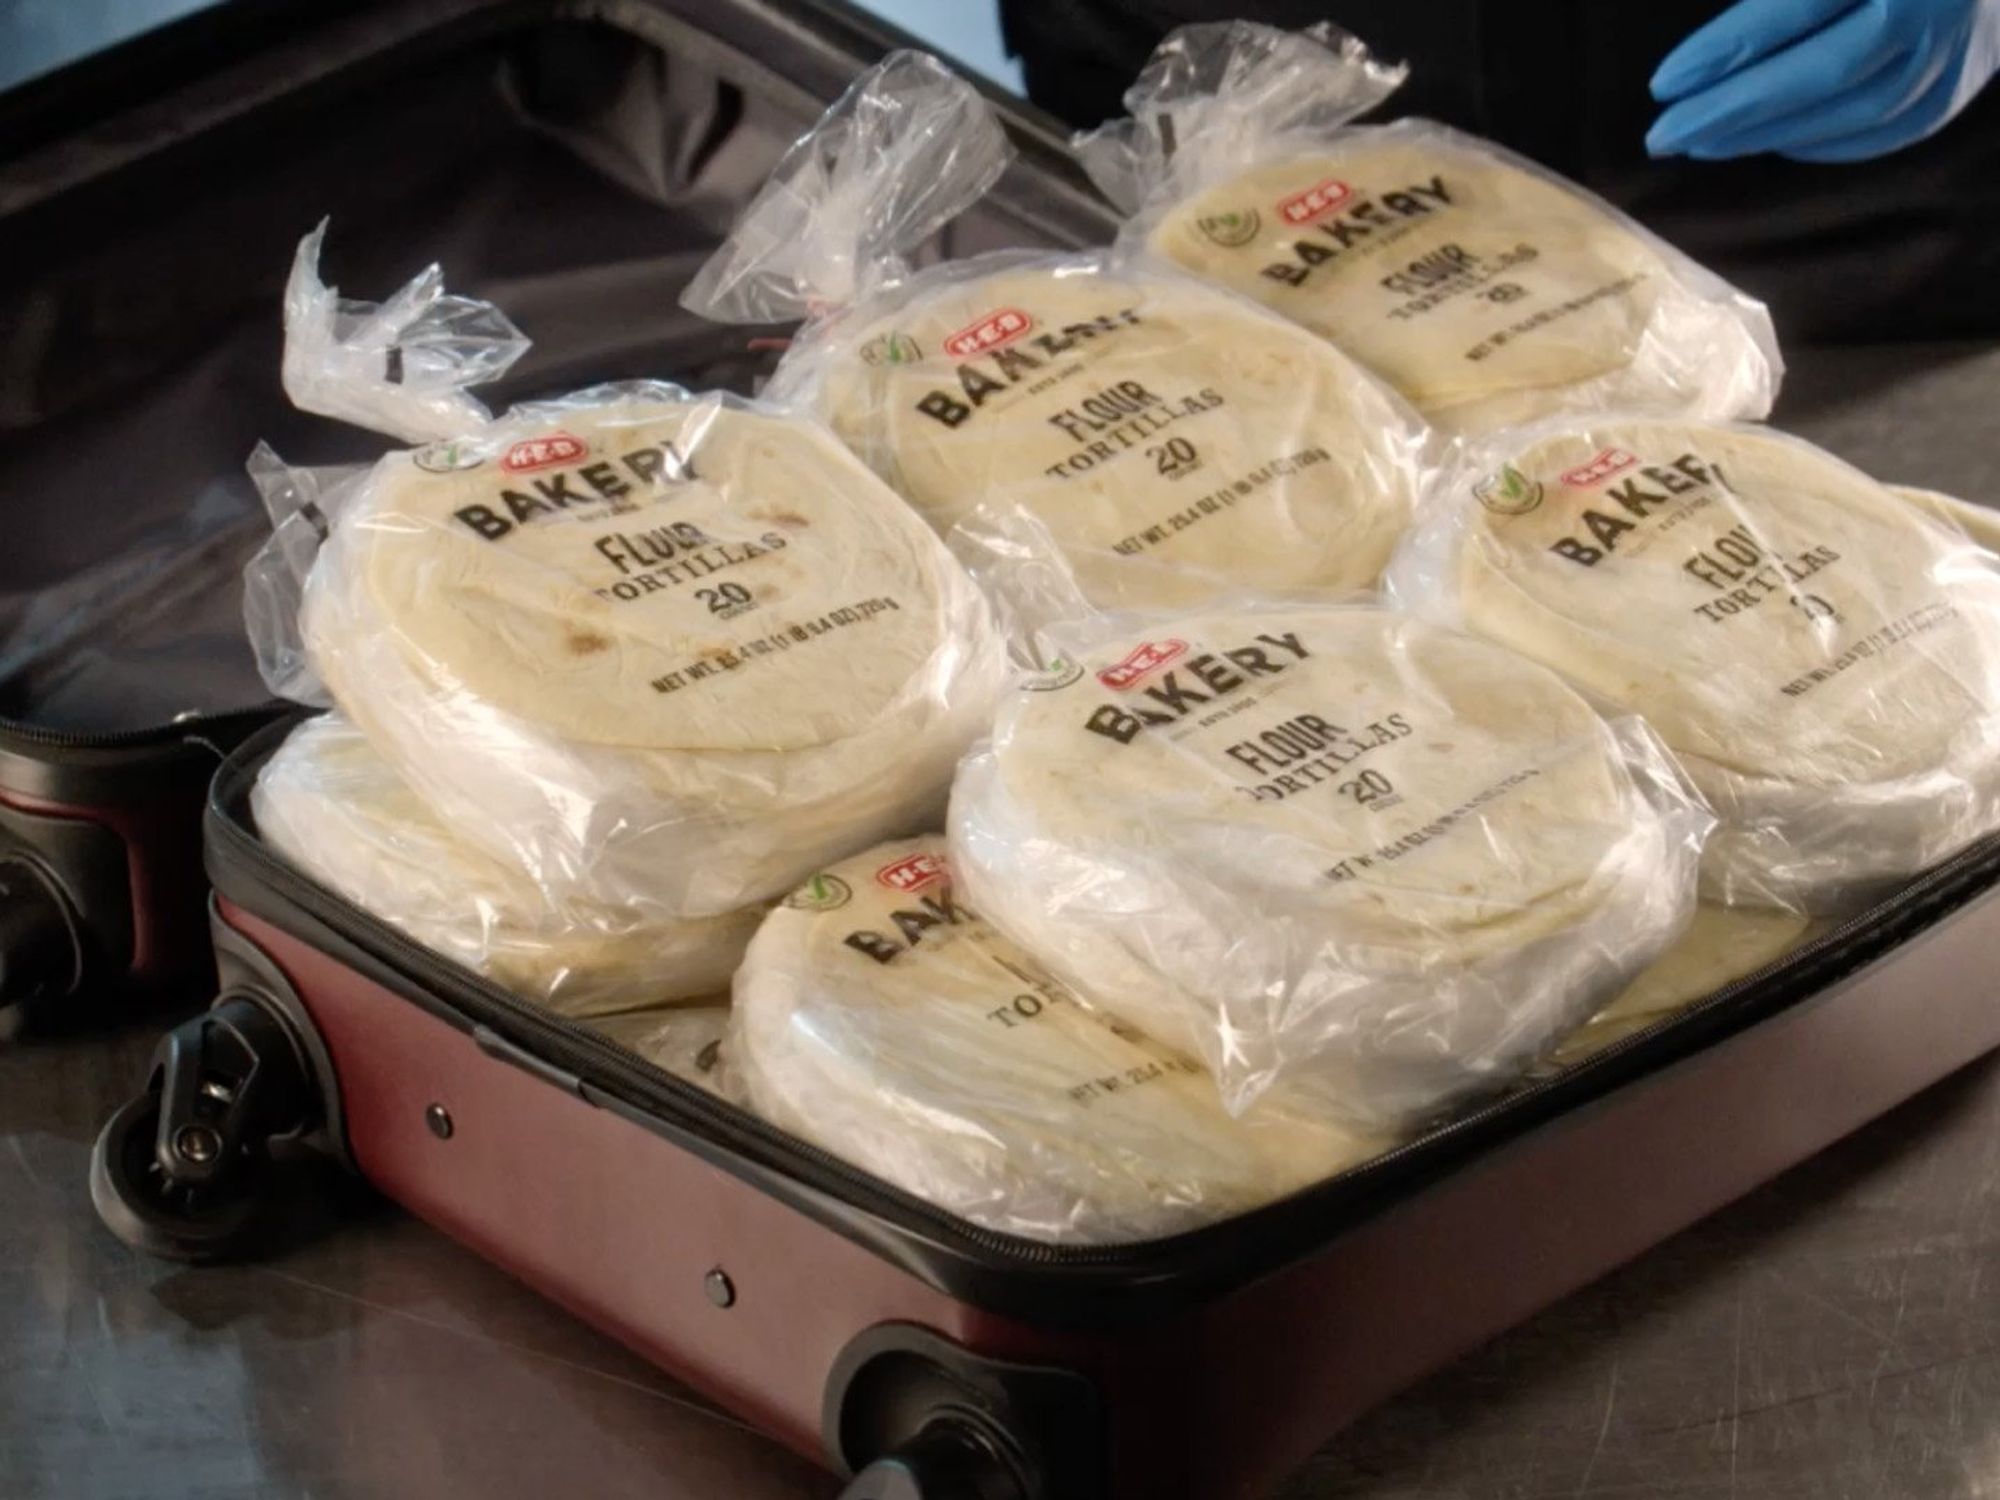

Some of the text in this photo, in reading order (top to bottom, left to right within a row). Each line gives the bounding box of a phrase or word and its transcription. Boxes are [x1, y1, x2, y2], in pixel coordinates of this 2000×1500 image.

[1045, 388, 1224, 479] TORTILLAS
[1049, 380, 1162, 442] FLOUR
[1145, 437, 1197, 476] 20
[1683, 523, 1770, 590] FLO
[1694, 544, 1842, 623] TORTLAS
[694, 581, 752, 614] 20
[650, 671, 687, 694] NET
[1227, 713, 1348, 776] FLOUR
[1338, 768, 1394, 805] 20
[843, 886, 977, 965] BAK
